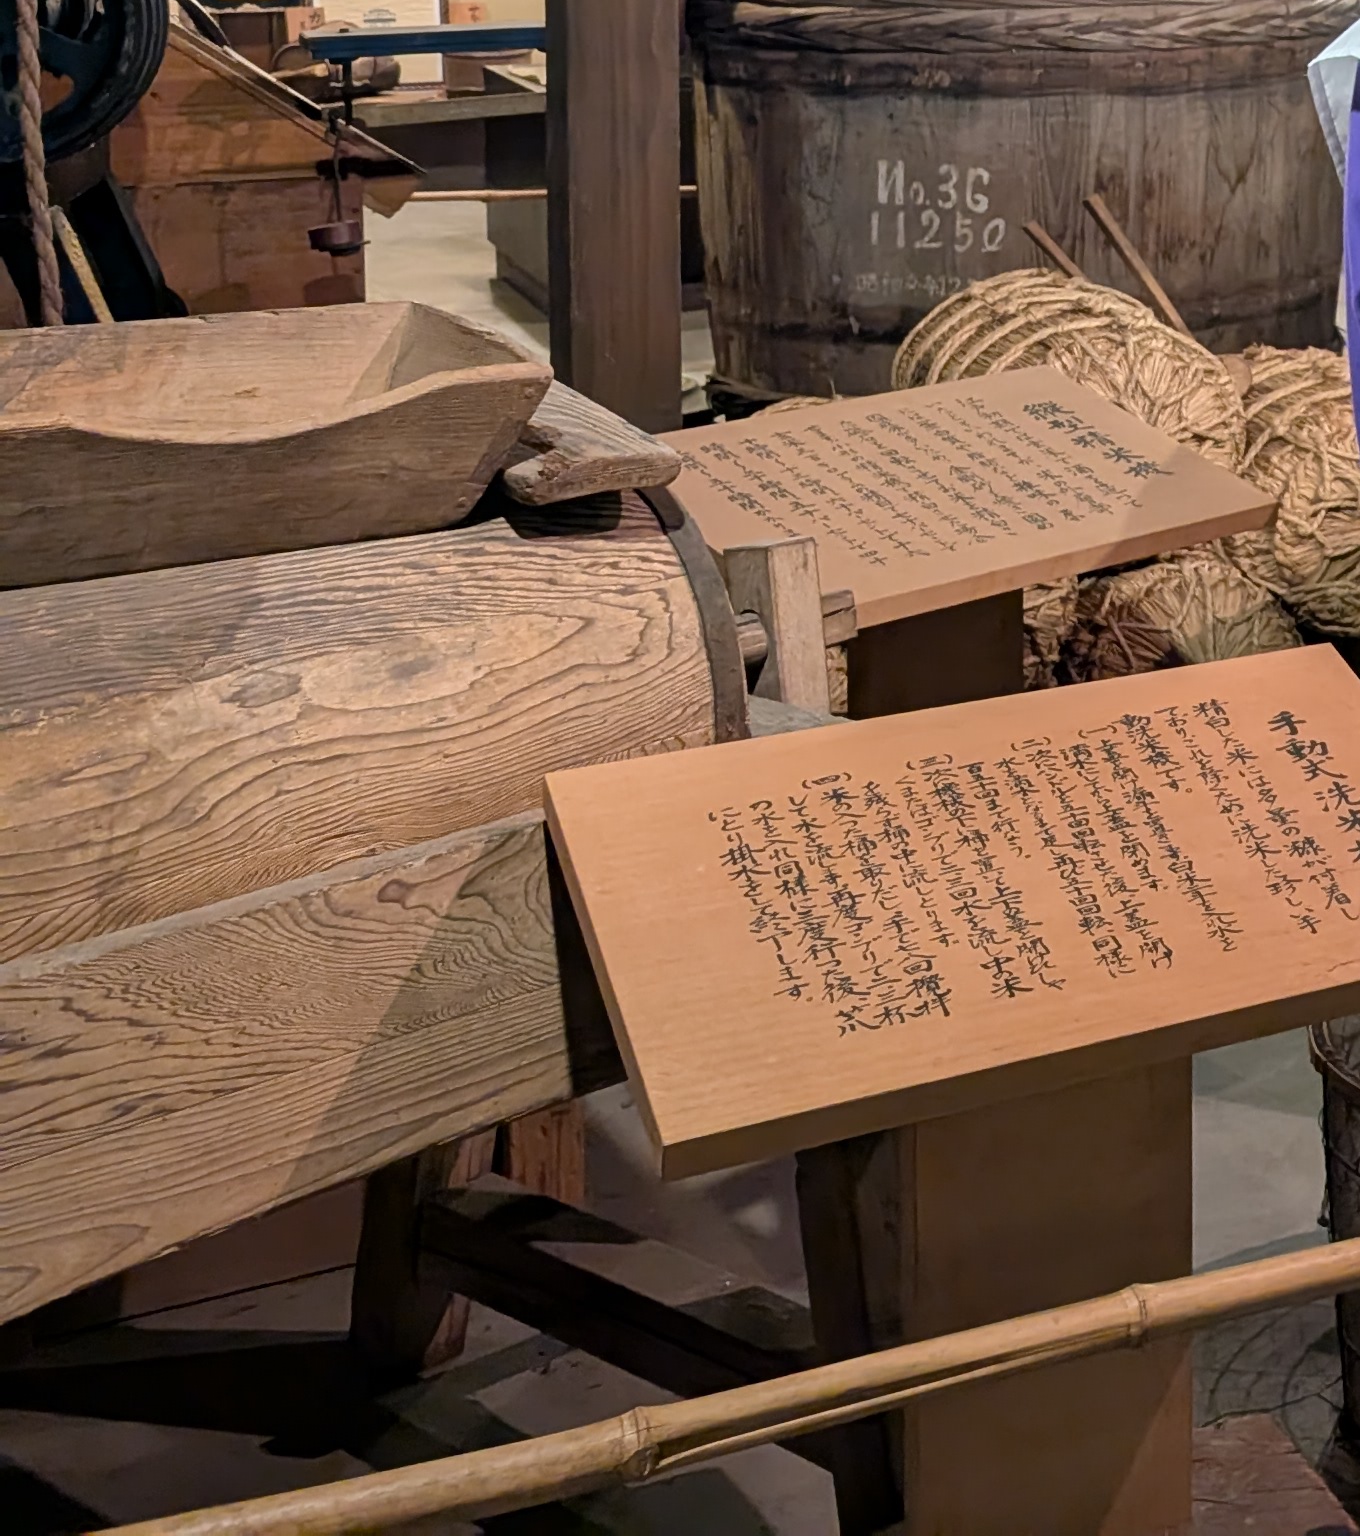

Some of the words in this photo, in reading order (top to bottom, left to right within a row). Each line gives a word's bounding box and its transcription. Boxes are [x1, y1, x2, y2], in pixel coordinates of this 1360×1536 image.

[1023, 401, 1175, 479] 縦型精米機
